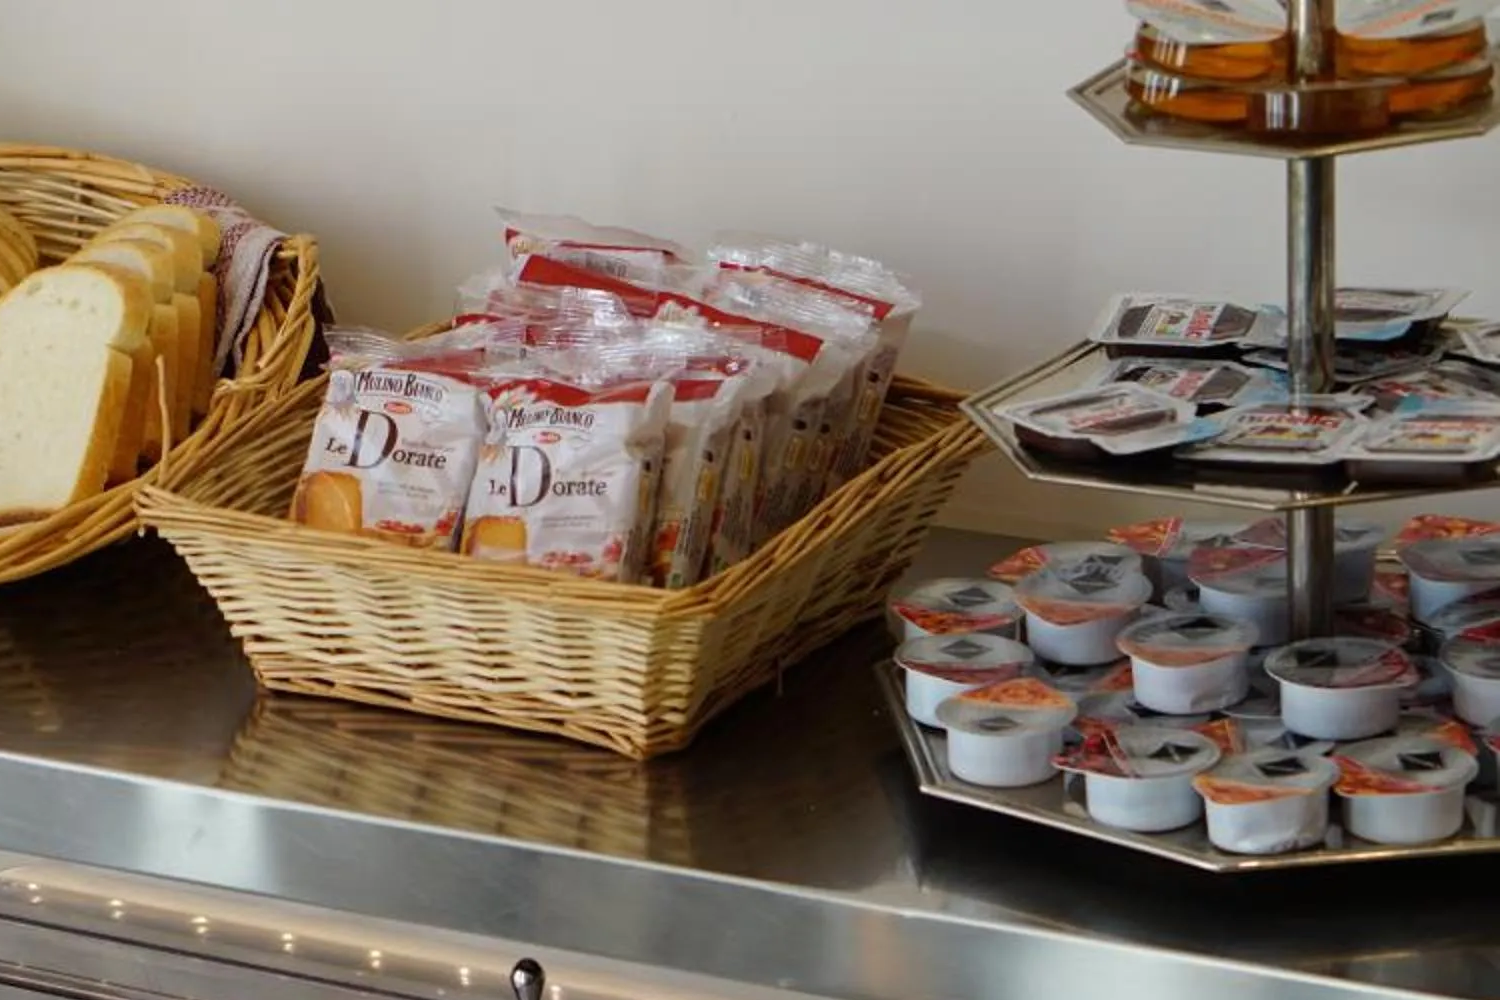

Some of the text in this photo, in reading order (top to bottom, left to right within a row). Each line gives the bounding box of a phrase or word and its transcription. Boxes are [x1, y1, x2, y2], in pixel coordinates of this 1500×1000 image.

[325, 410, 448, 470] Le Dorate
[488, 446, 608, 508] Le Dorate
